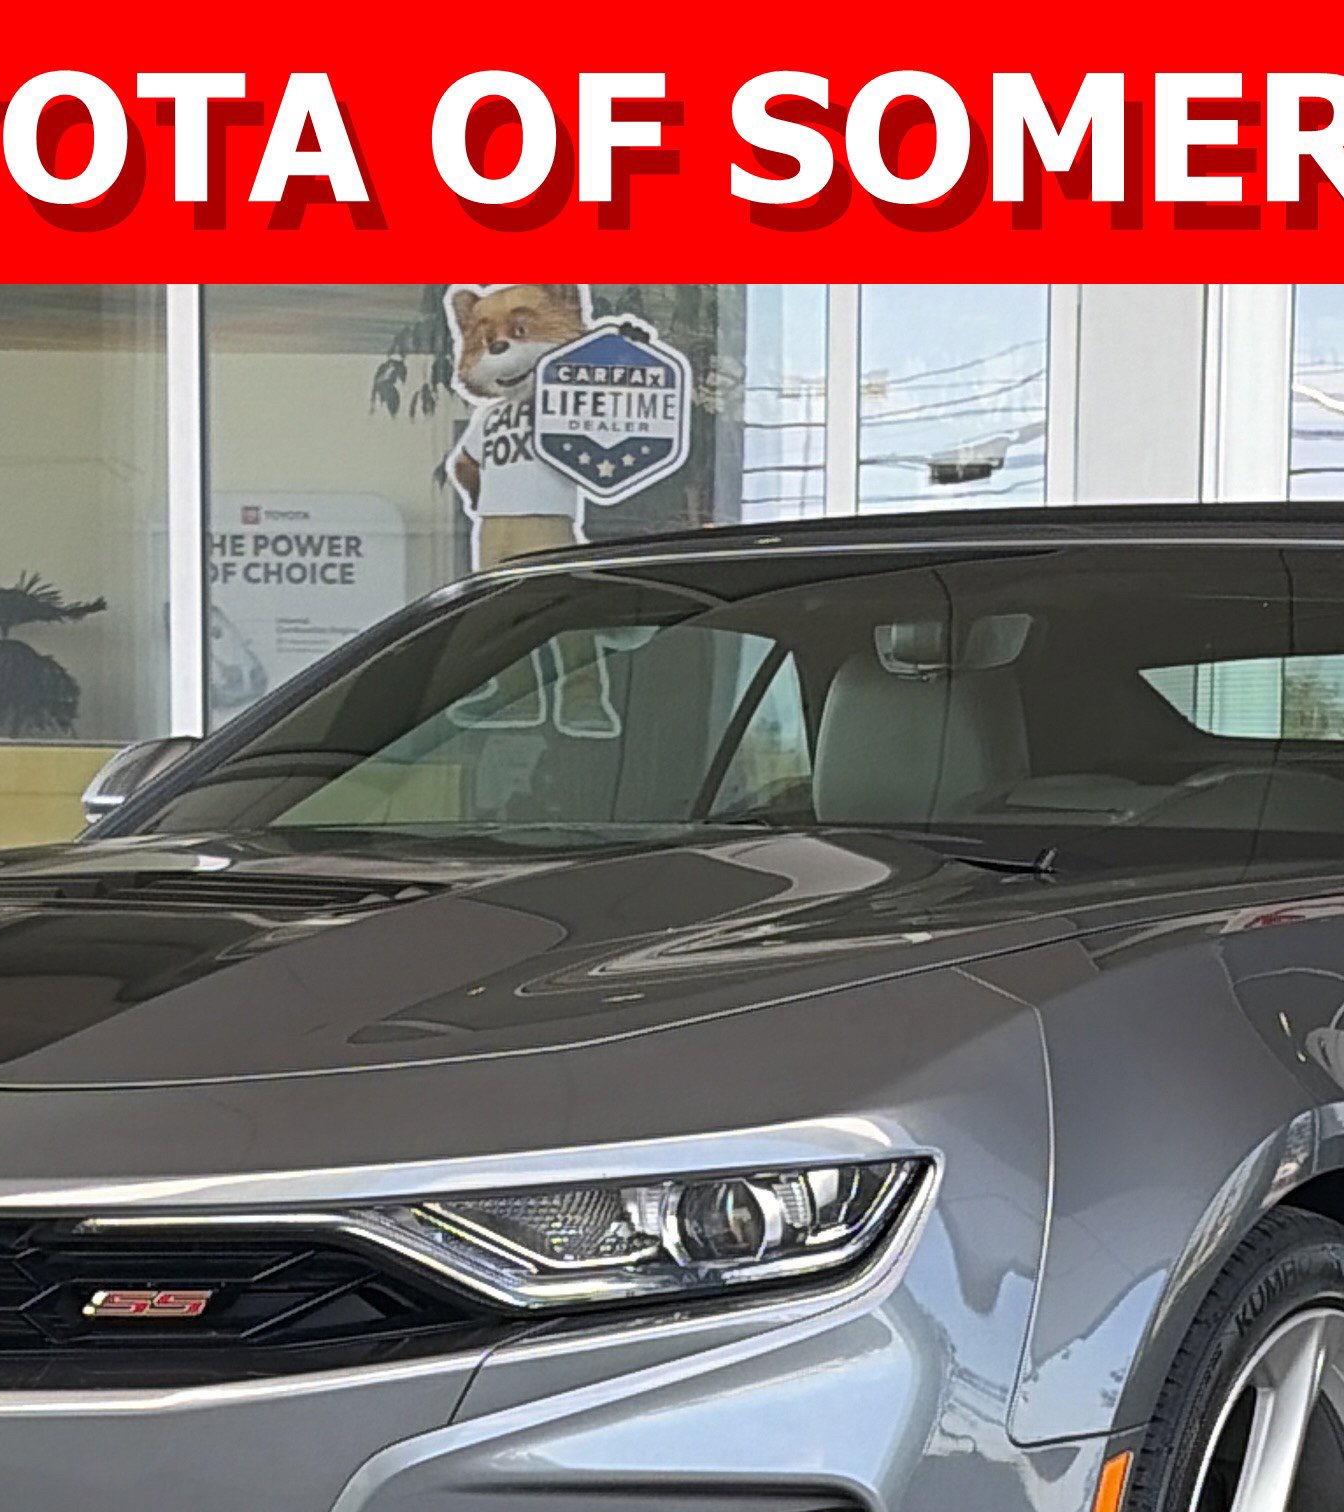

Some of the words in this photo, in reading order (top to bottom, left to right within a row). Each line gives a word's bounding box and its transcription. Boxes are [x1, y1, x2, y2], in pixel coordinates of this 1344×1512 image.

[557, 365, 665, 387] CARFAX
[541, 389, 676, 420] LIFETIME
[568, 420, 650, 432] DEALER
[483, 433, 535, 470] FOX
[264, 510, 311, 520] TOYOTA
[206, 533, 245, 557] HE
[253, 534, 364, 558] POWER
[243, 562, 356, 585] CHOICE
[82, 1290, 214, 1317] SS
